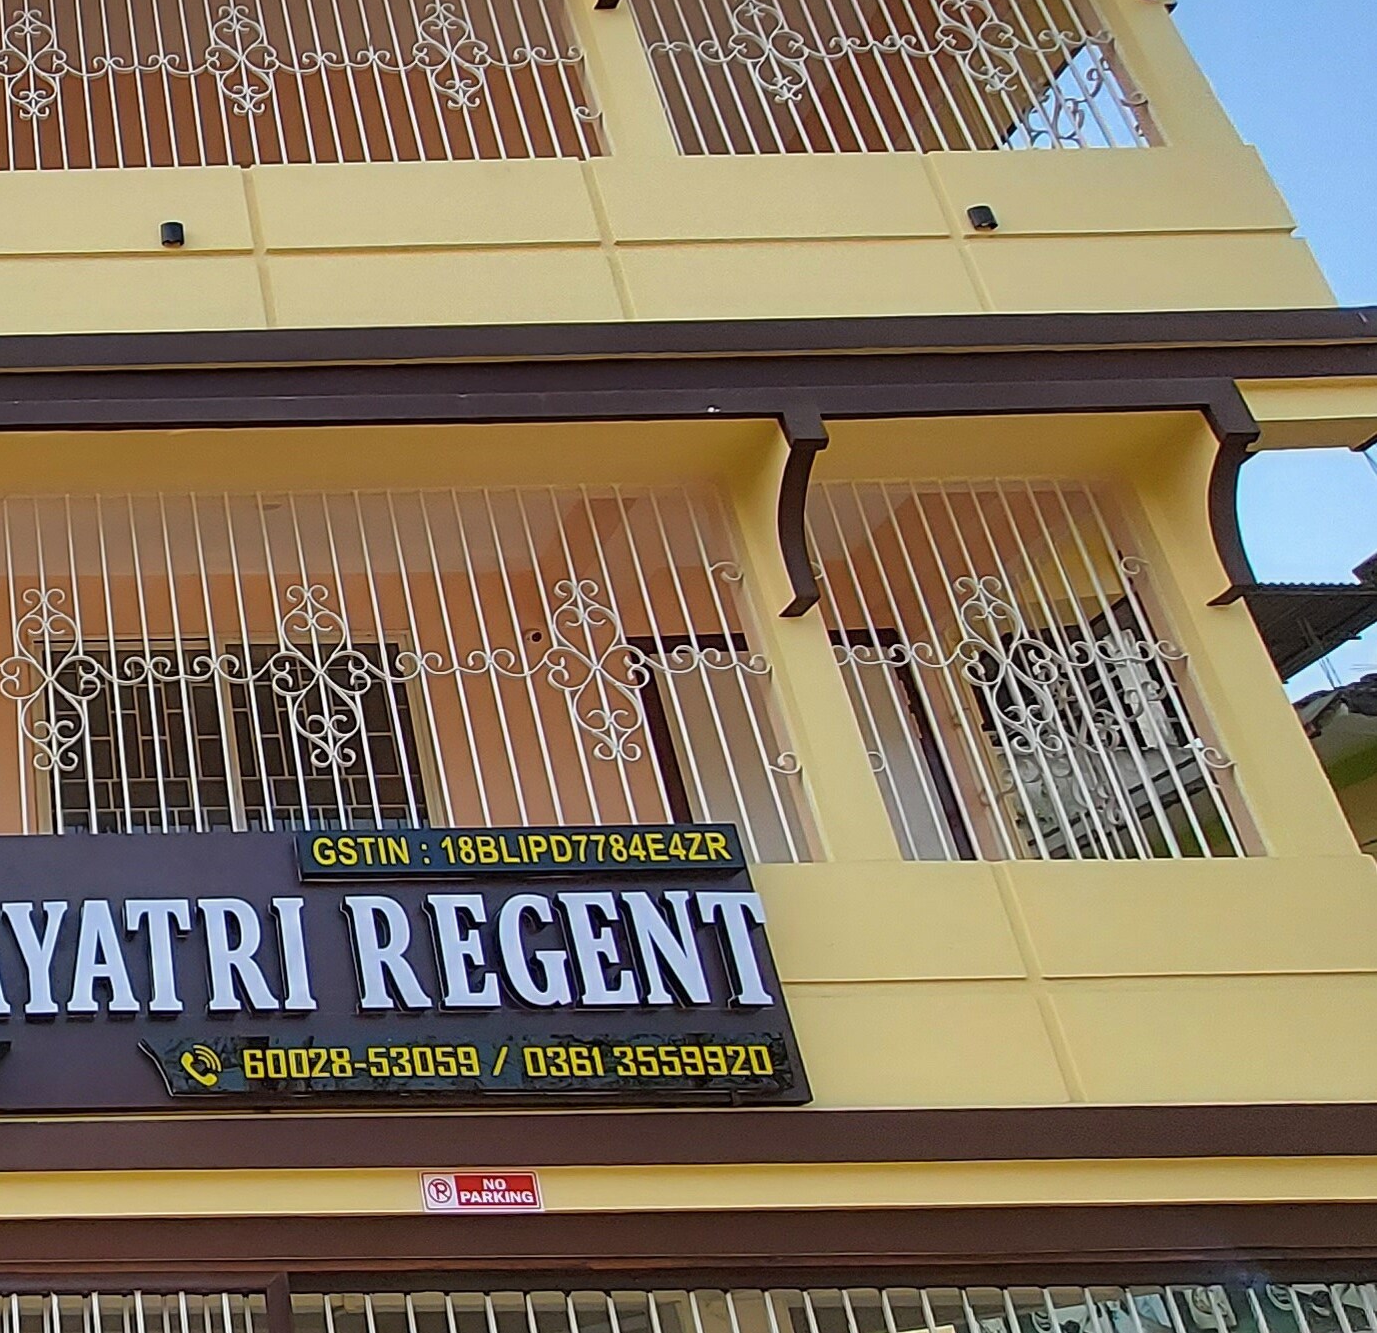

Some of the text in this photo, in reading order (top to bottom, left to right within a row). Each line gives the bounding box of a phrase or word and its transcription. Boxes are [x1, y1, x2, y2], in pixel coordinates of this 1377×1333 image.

[311, 831, 732, 867] GSTIN : 18BLIPD7784E4ZR
[343, 889, 776, 1011] REGENT
[242, 1046, 481, 1080] 60028-53059
[522, 1045, 605, 1078] 0361
[611, 1044, 775, 1077] 3559920
[459, 1190, 535, 1203] PARKING
[482, 1178, 507, 1190] NO
